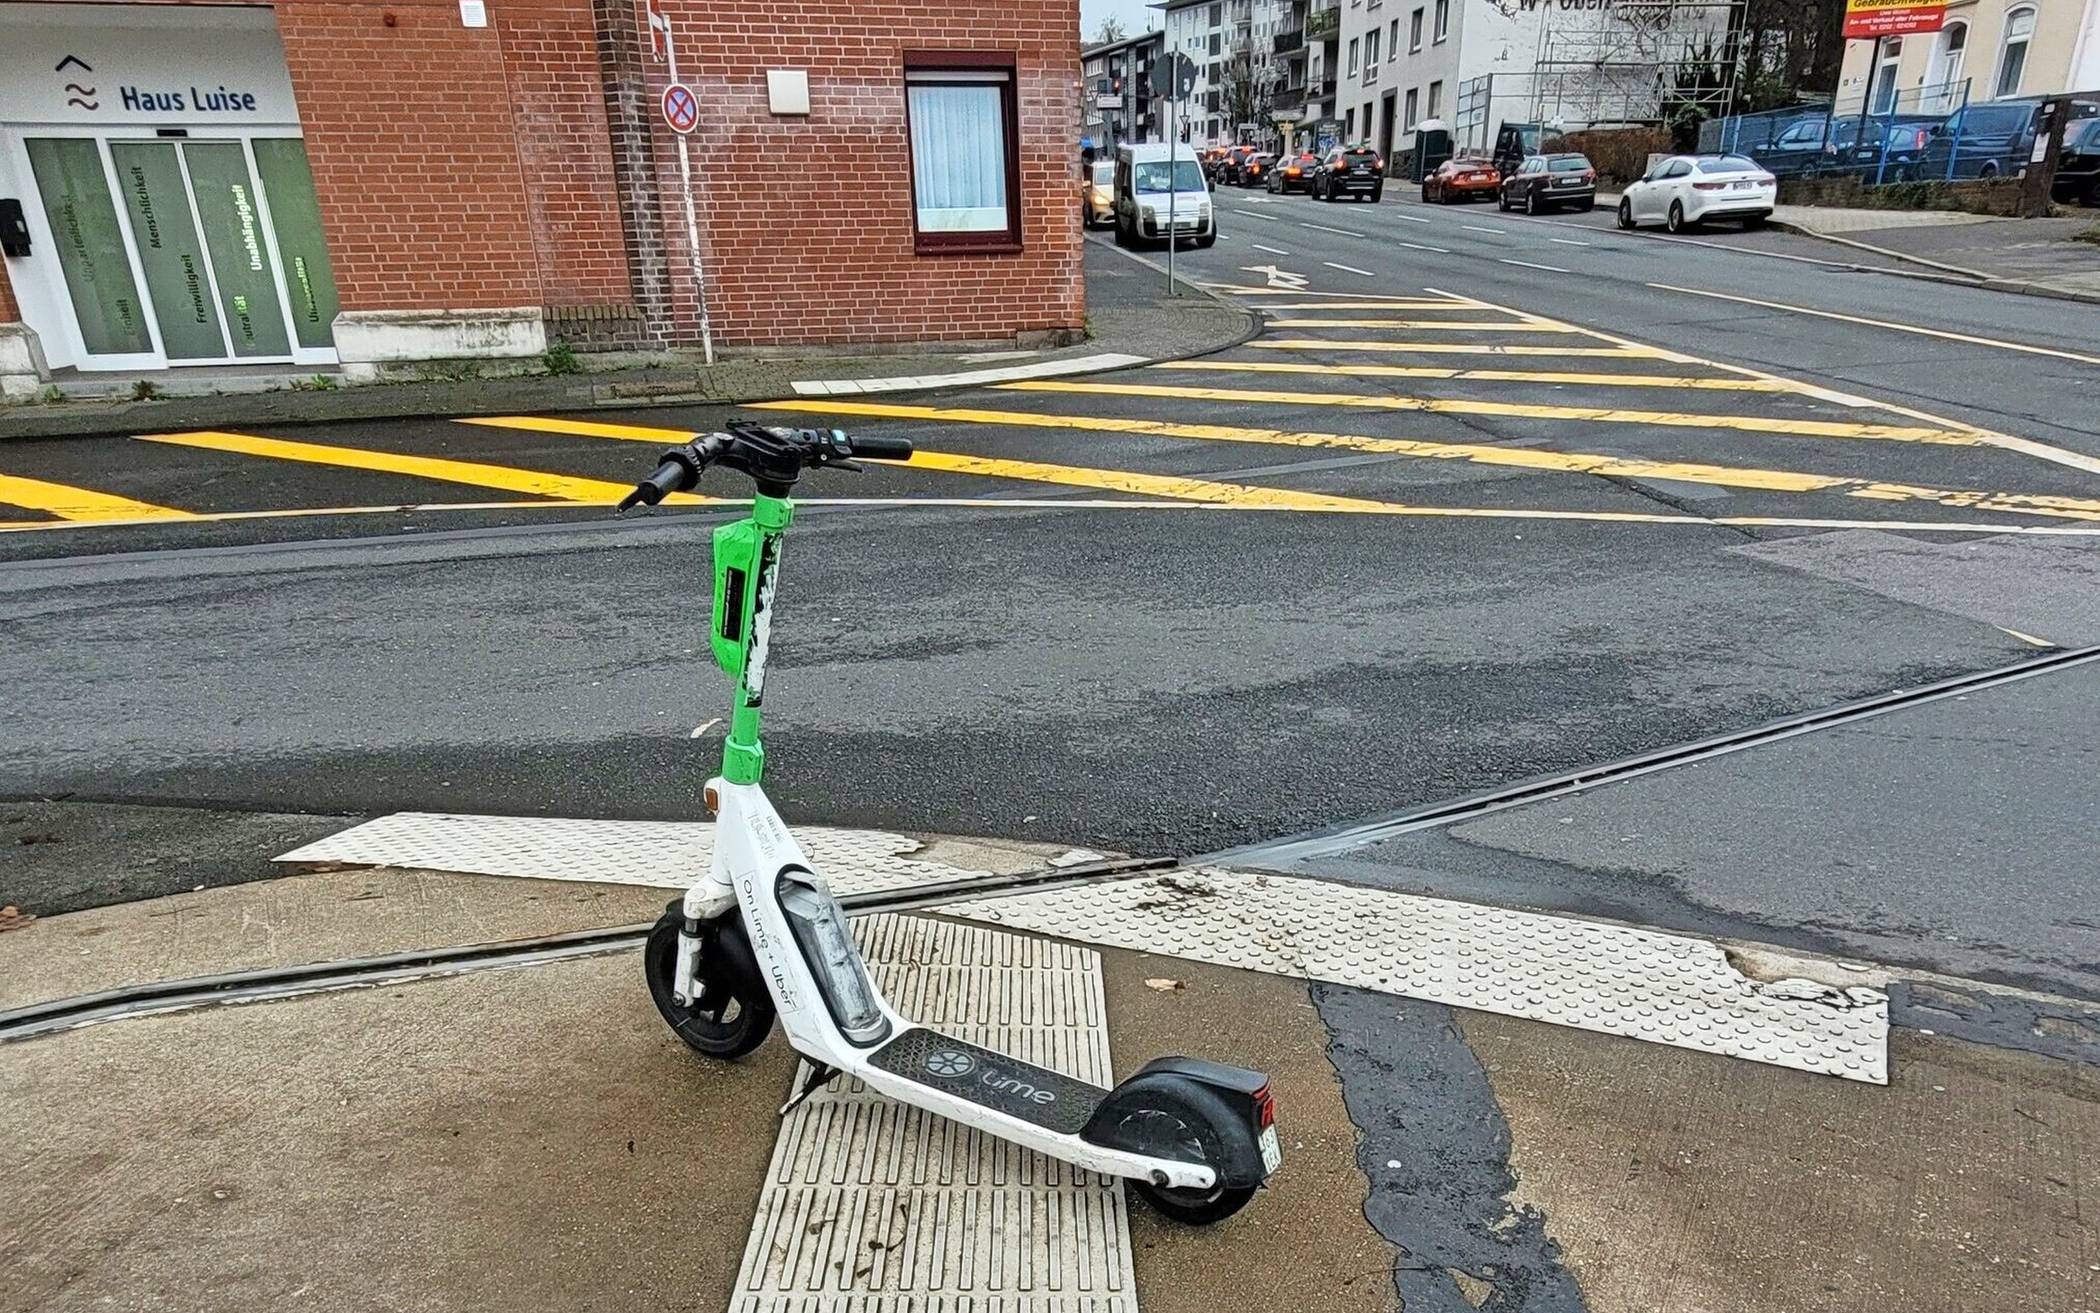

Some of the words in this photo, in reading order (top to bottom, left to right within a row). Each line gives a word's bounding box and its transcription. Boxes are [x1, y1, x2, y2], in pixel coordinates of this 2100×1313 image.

[120, 86, 185, 111] Haus
[191, 86, 256, 111] Luise
[131, 166, 162, 249] Menschlichkeit
[232, 184, 263, 271] Unabhängigkeit
[181, 254, 207, 323] Freiwilligkeit
[234, 295, 256, 349] utralität
[743, 879, 755, 906] On
[751, 908, 769, 950] Lime
[771, 965, 793, 1005] Uber
[982, 1070, 1056, 1105] Lime
